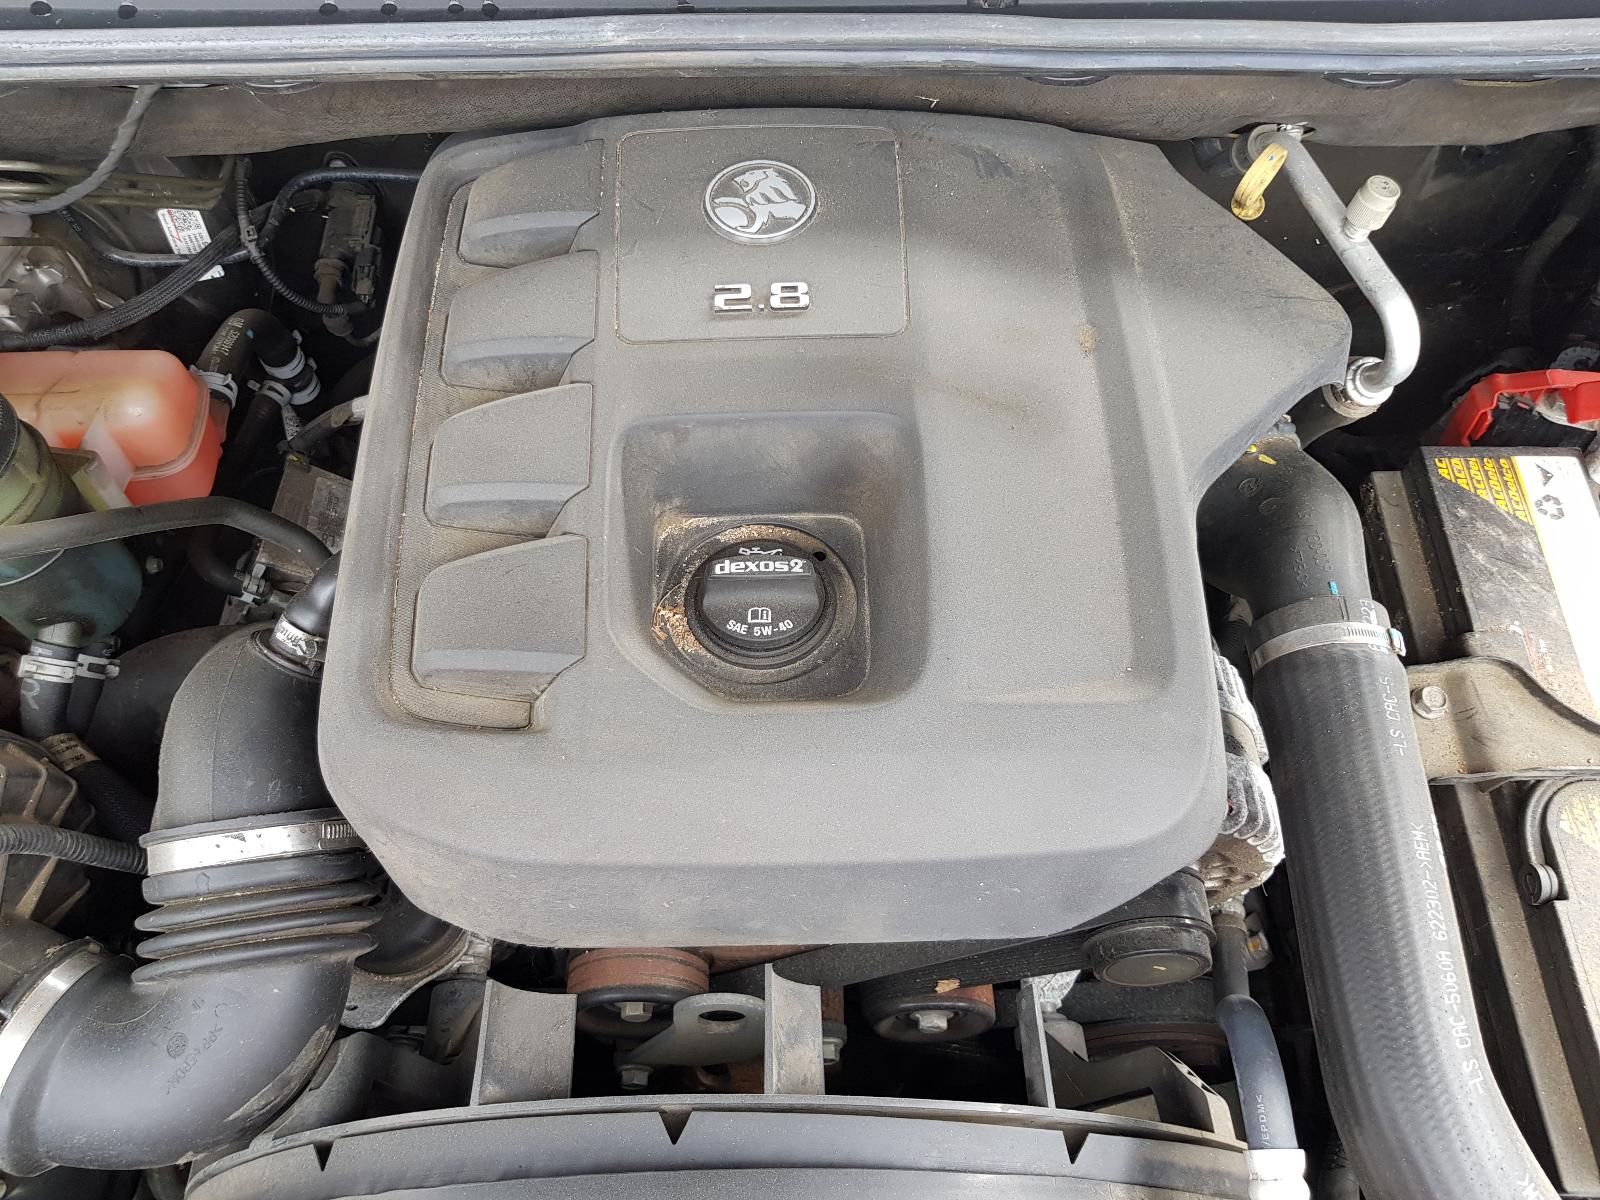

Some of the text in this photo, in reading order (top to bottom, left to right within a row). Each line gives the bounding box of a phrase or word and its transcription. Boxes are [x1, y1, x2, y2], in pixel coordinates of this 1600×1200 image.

[714, 282, 810, 312] 2.8
[1500, 458, 1528, 522] ACDelco
[714, 558, 804, 575] dexos2
[726, 619, 794, 637] SAE 5W-40
